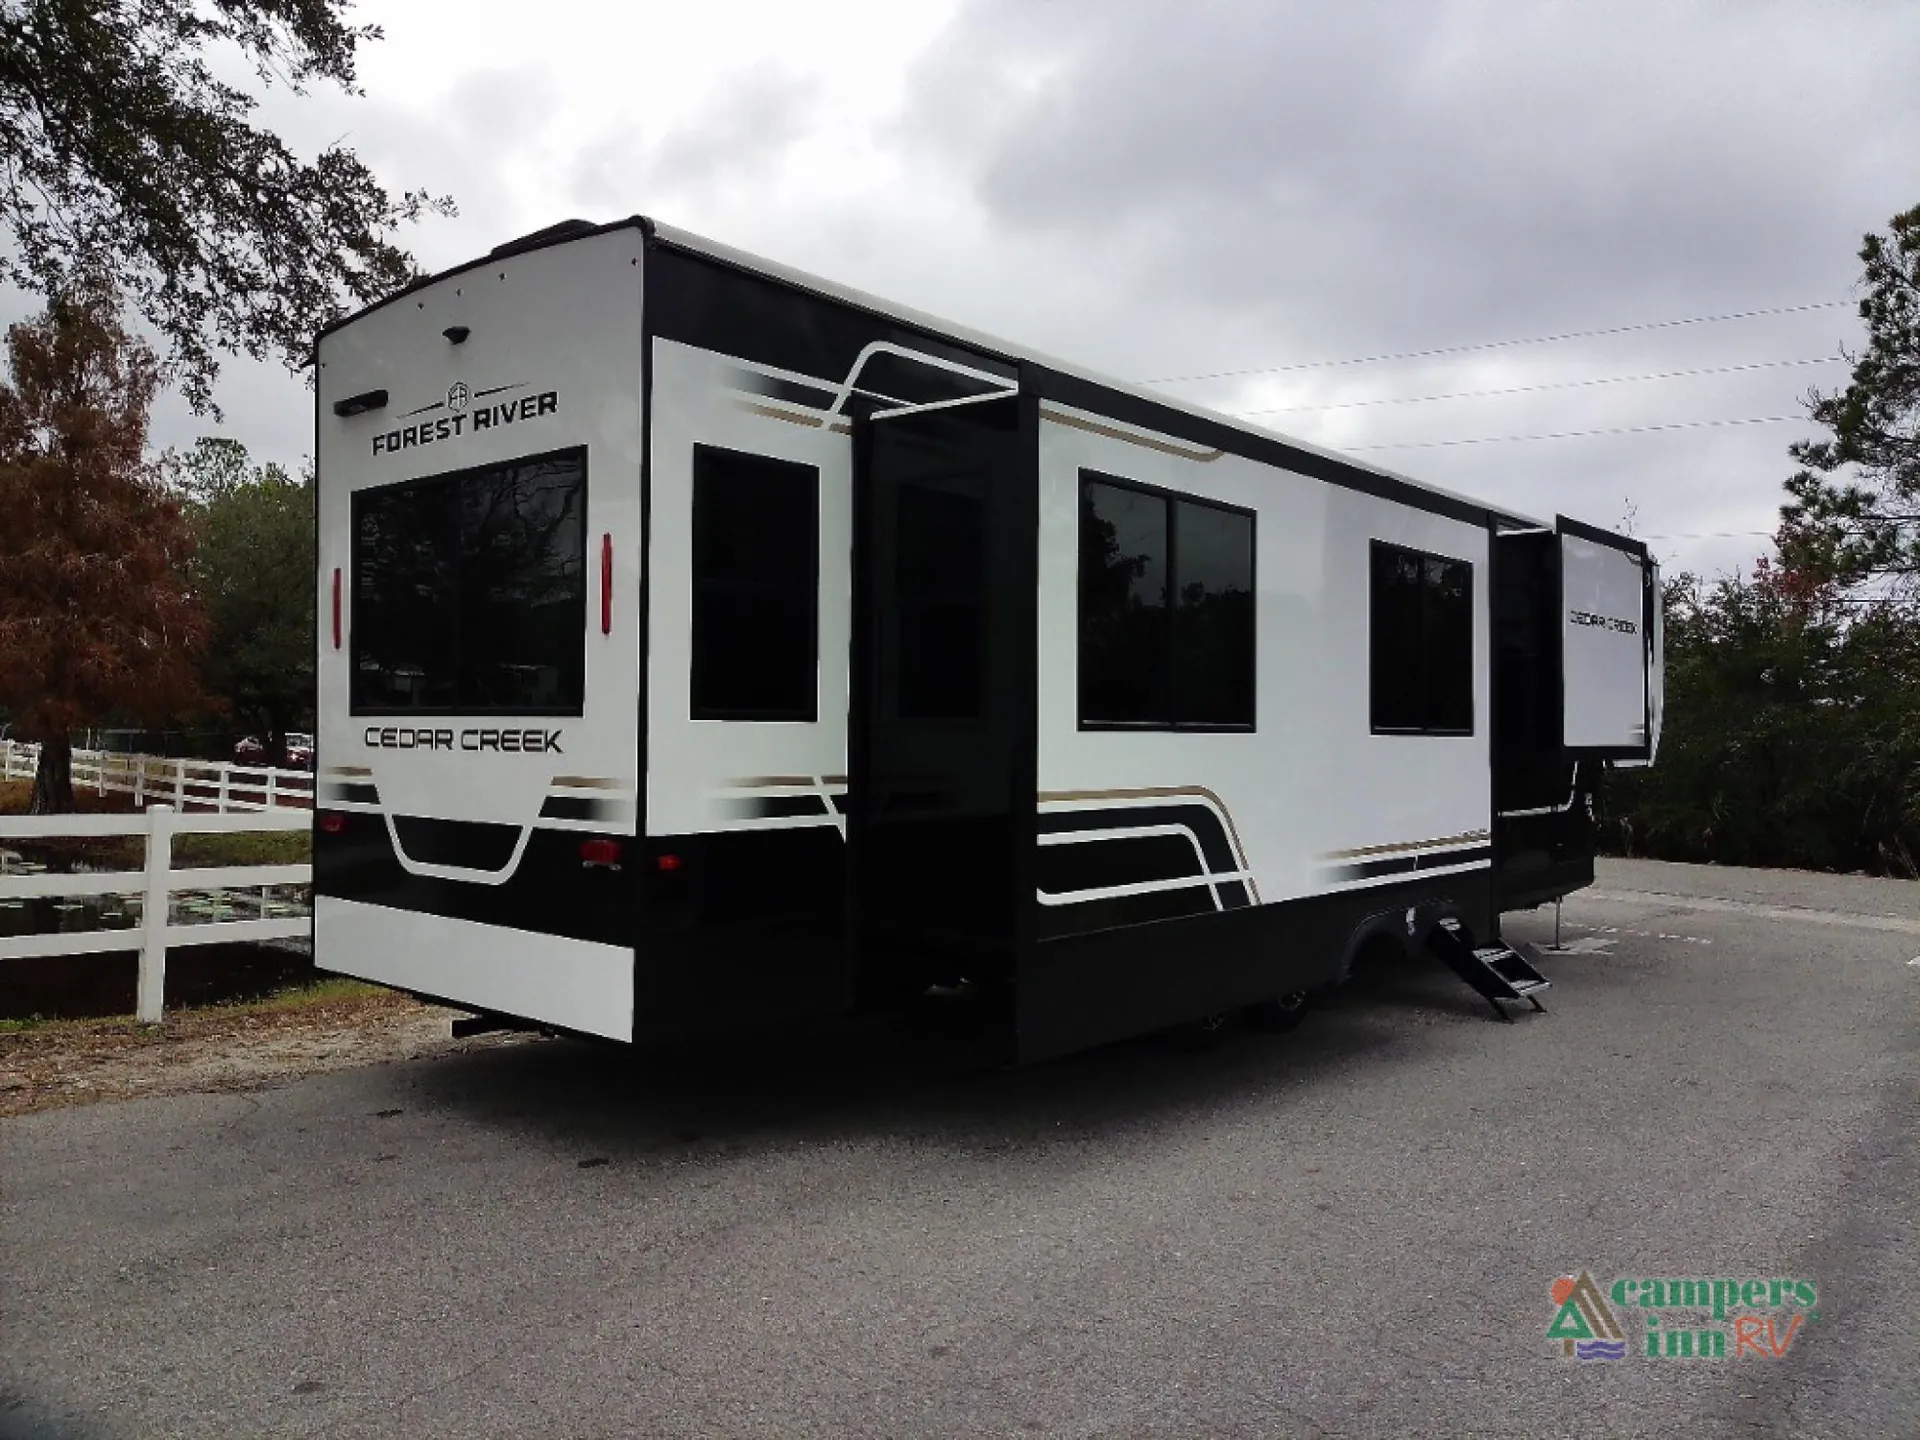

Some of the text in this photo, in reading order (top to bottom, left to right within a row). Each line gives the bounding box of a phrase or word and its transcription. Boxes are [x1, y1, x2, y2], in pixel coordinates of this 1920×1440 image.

[371, 391, 559, 456] FOREST RIVER
[364, 726, 564, 753] CEDAR CREEK
